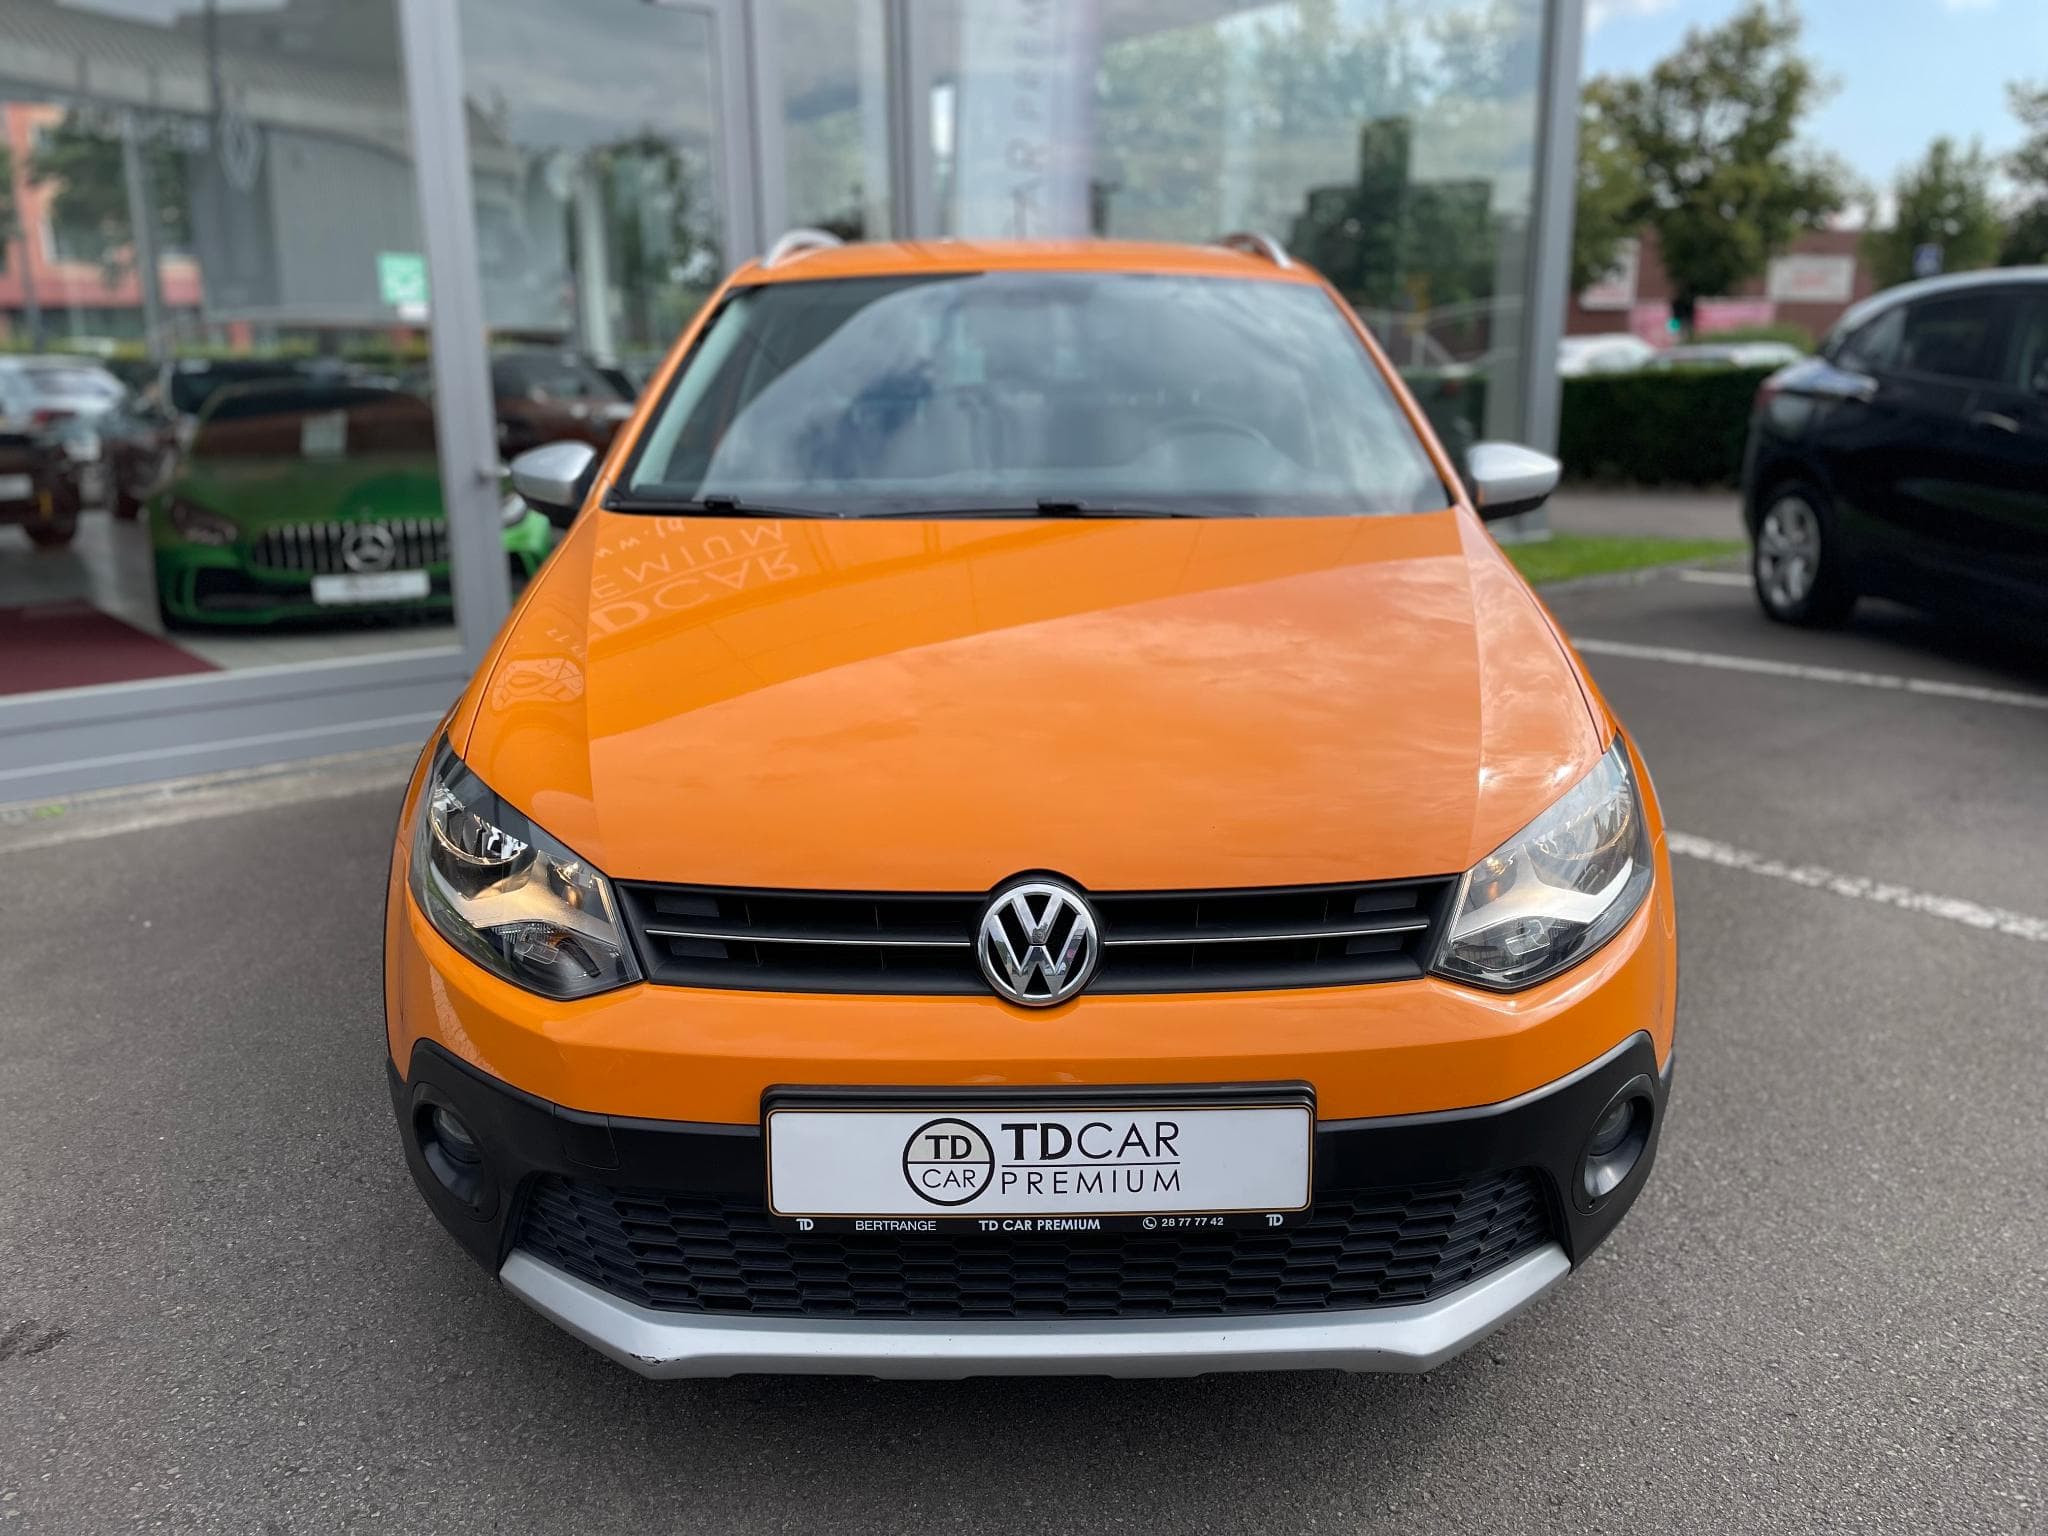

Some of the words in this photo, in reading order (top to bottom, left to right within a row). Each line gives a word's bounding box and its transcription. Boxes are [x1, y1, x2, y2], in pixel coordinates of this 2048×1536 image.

[925, 1135, 972, 1160] TD
[1001, 1121, 1180, 1160] TDCAR
[922, 1169, 976, 1188] CAR
[1001, 1169, 1181, 1195] PREMIUM
[796, 1218, 814, 1231] TD
[855, 1220, 937, 1231] BERTRANGE
[978, 1219, 999, 1232] TD
[1002, 1219, 1033, 1232] CAR
[1037, 1217, 1101, 1231] PREMIUM
[1161, 1217, 1176, 1228] 28
[1178, 1217, 1192, 1228] 77
[1194, 1216, 1208, 1227] 77
[1209, 1216, 1224, 1227] 42
[1266, 1213, 1284, 1227] TD
